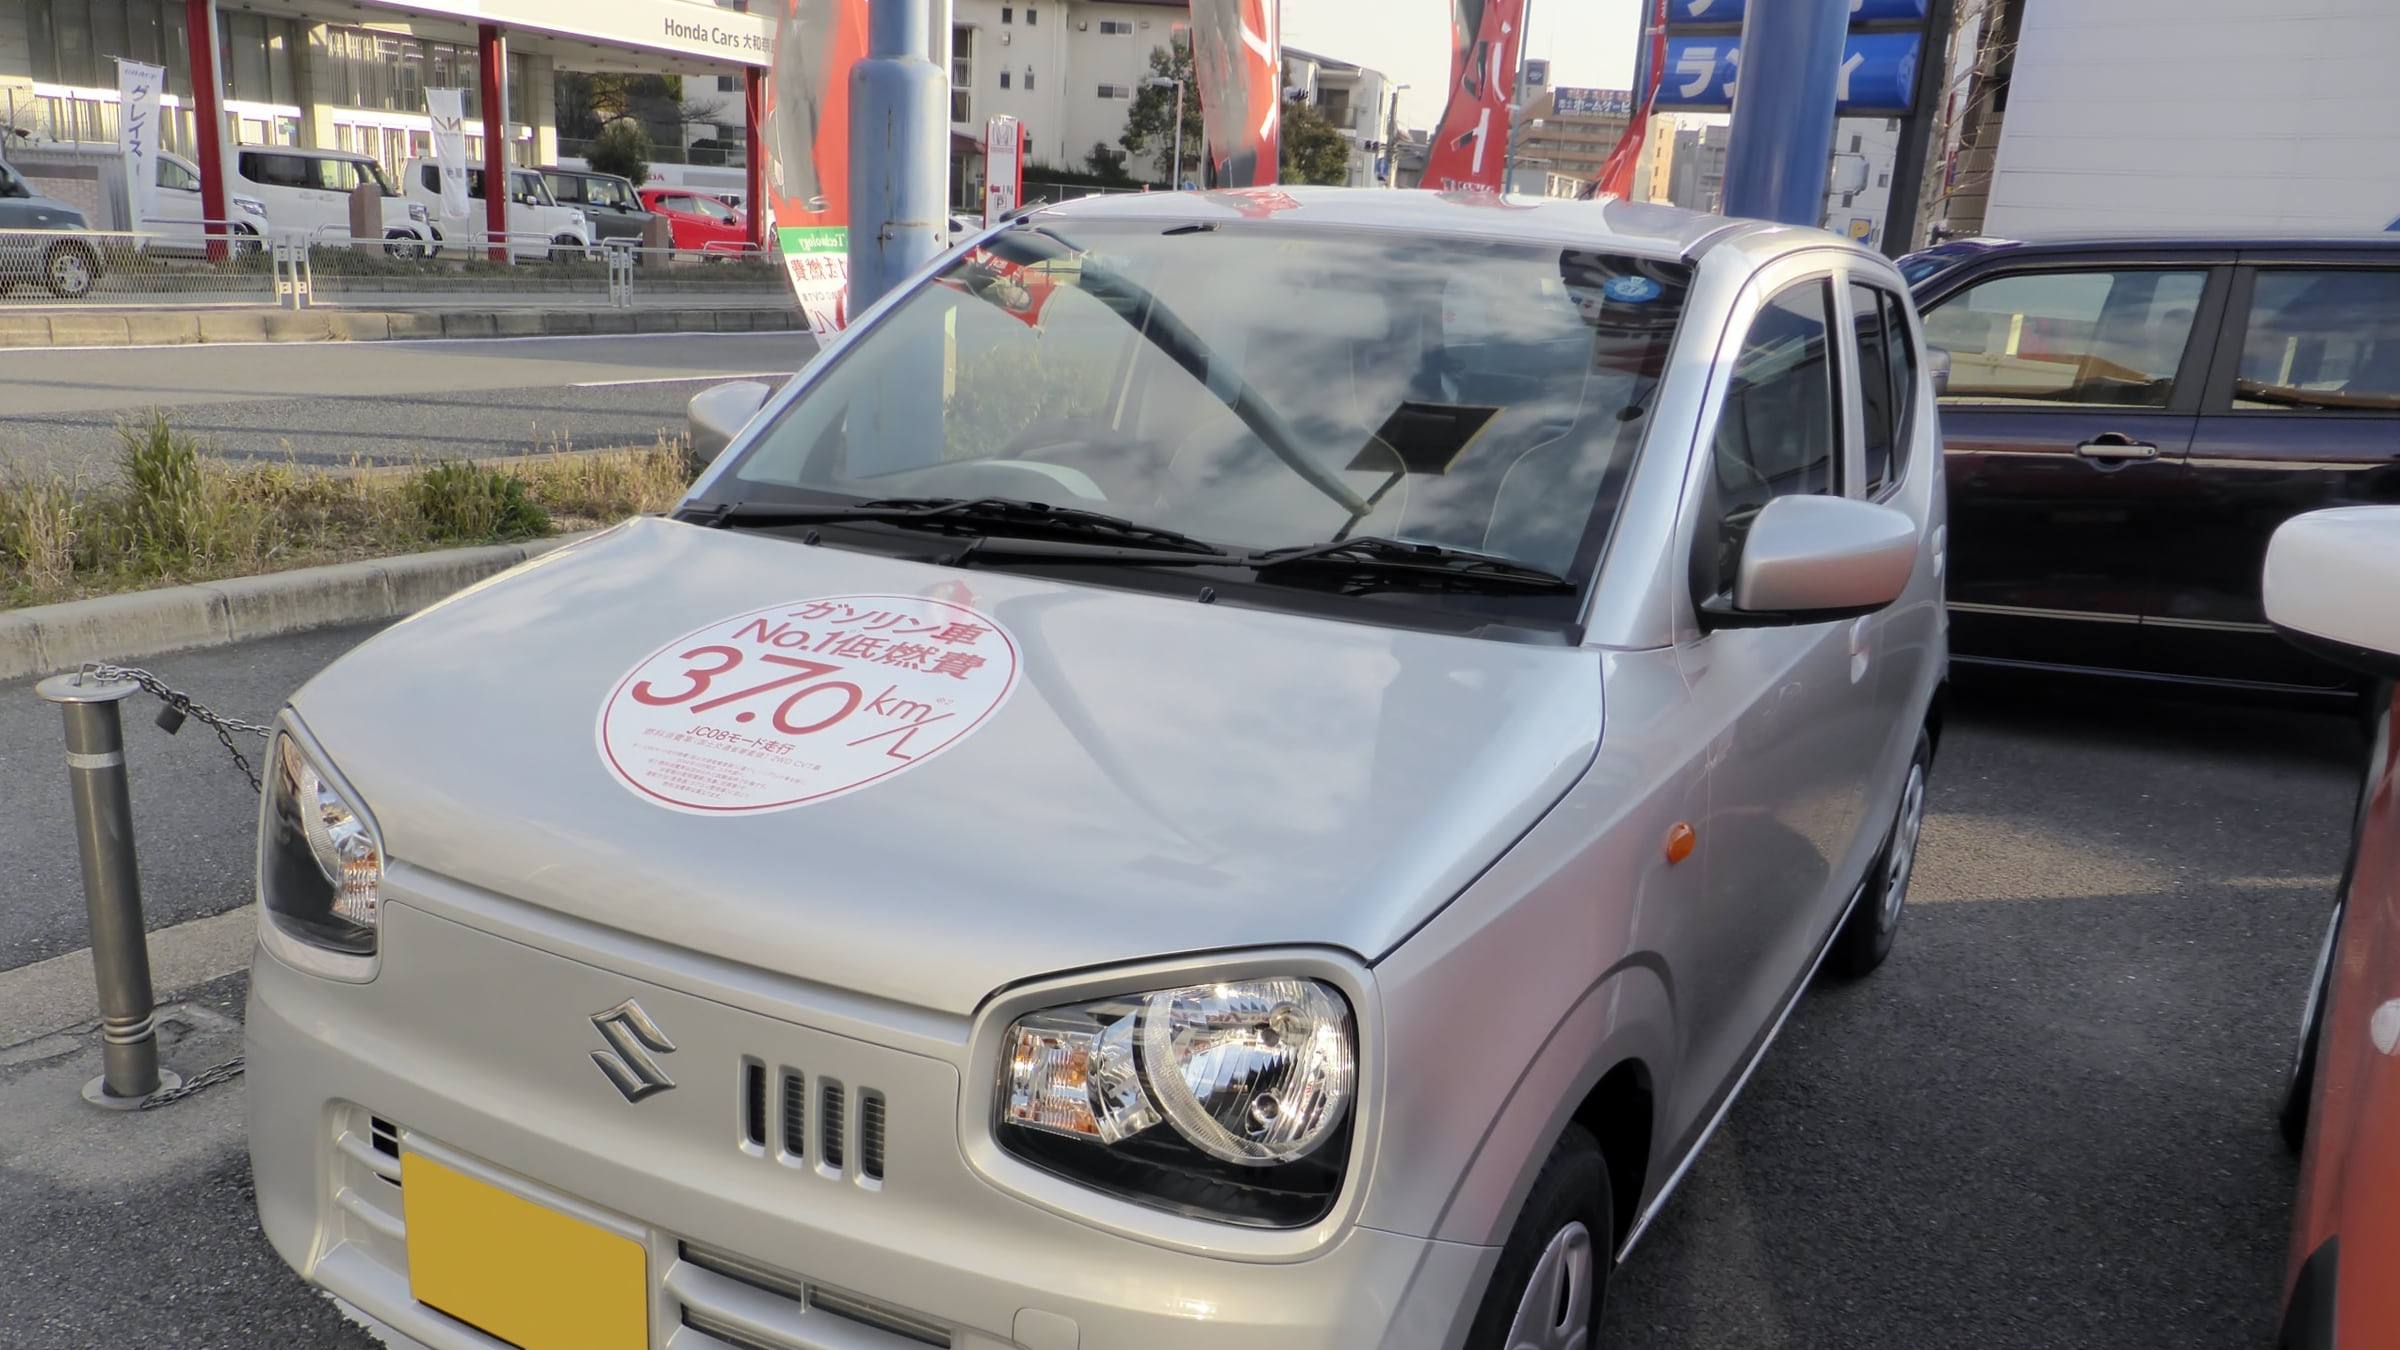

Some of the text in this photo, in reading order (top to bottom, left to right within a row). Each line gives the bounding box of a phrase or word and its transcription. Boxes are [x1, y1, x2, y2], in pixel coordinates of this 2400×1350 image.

[664, 17, 708, 42] Honda
[711, 27, 740, 48] Cars
[128, 84, 150, 158] グレイス
[787, 601, 993, 646] ガソリン車
[631, 645, 863, 735] 37.0
[686, 725, 796, 757] JC08モード走行
